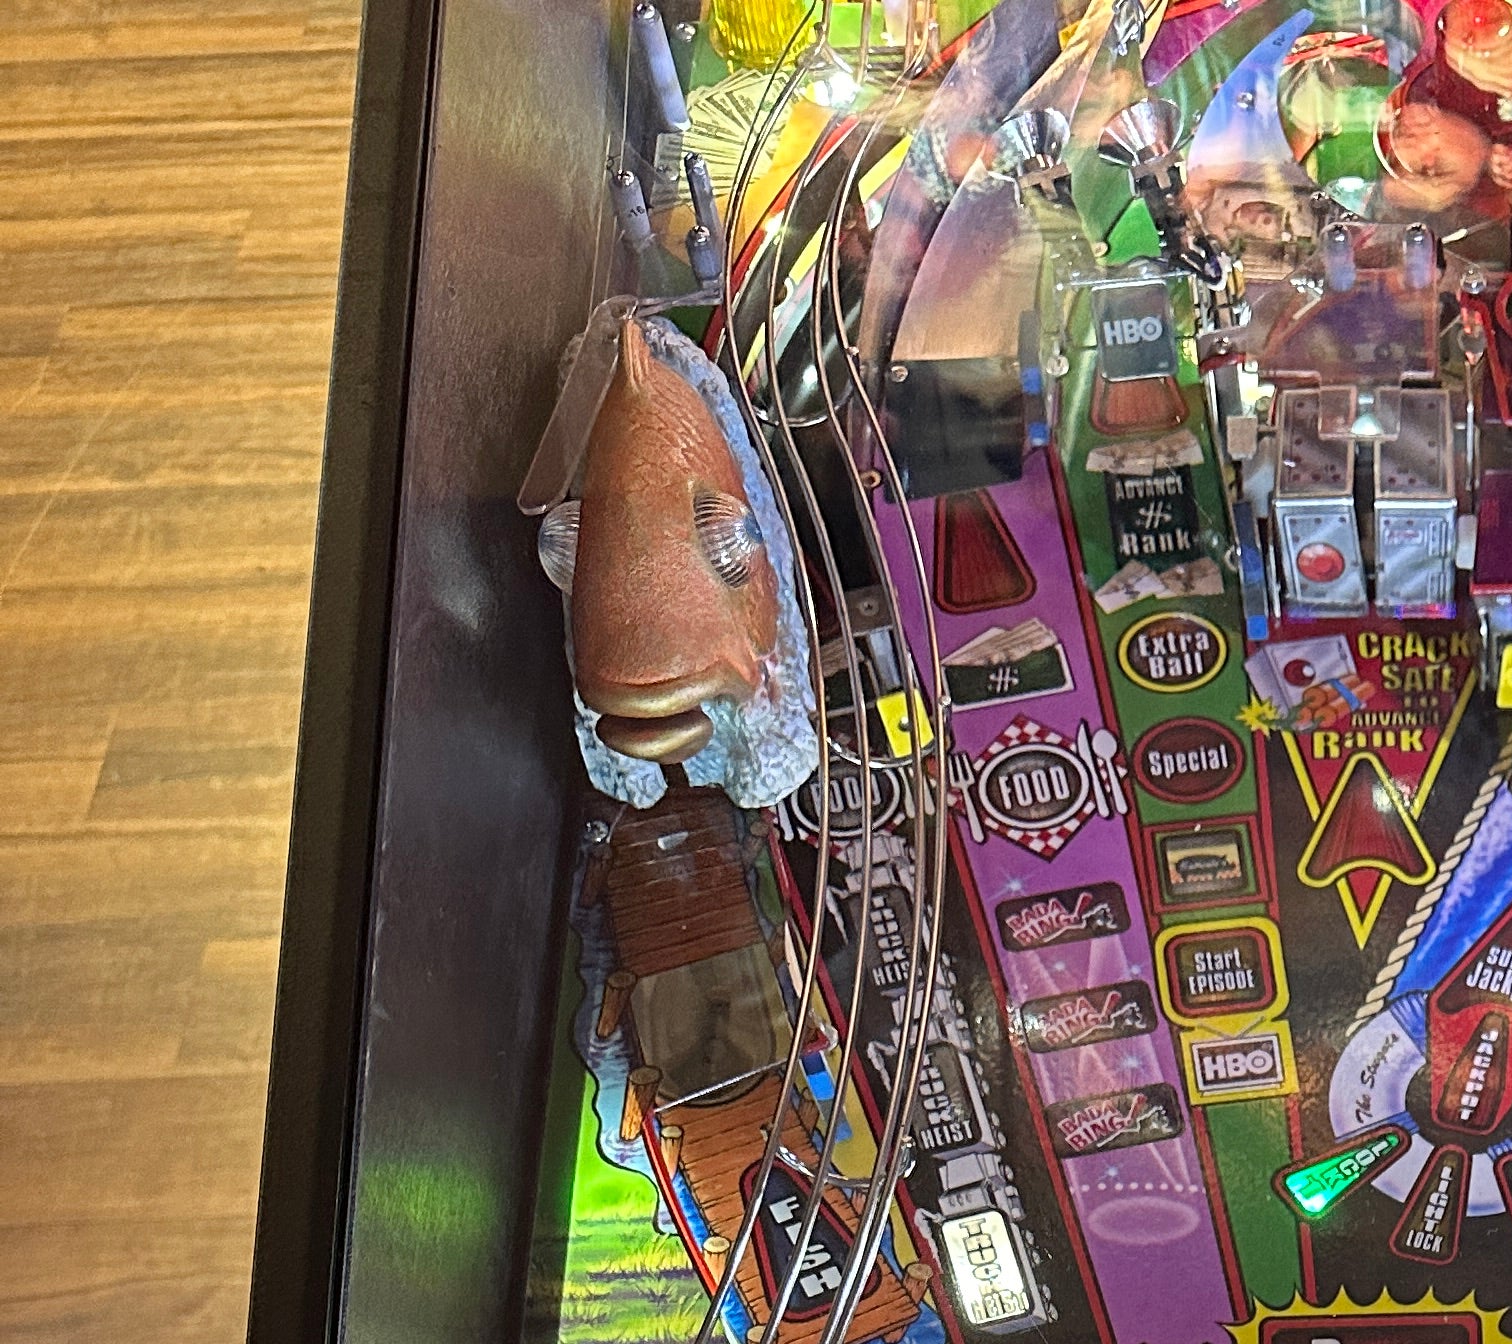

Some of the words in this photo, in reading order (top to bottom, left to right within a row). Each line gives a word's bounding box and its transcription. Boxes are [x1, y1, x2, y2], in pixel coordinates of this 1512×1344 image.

[1103, 315, 1163, 346] HBO
[1120, 527, 1191, 556] Rank
[1137, 630, 1210, 658] Extra
[1357, 630, 1470, 663] CRACK
[1148, 652, 1204, 680] Ball
[1150, 745, 1228, 780] Special
[999, 765, 1072, 810] FOOD
[1006, 898, 1067, 933] BADA
[1194, 948, 1241, 972] Start
[1188, 969, 1255, 996] EPISODE
[1203, 1049, 1273, 1080] HBO
[1460, 1029, 1500, 1120] JACKPOT
[1057, 1099, 1121, 1135] BADA
[919, 1118, 973, 1151] HEIST
[1424, 1166, 1453, 1233] LIGHT
[1405, 1231, 1445, 1254] LOCK
